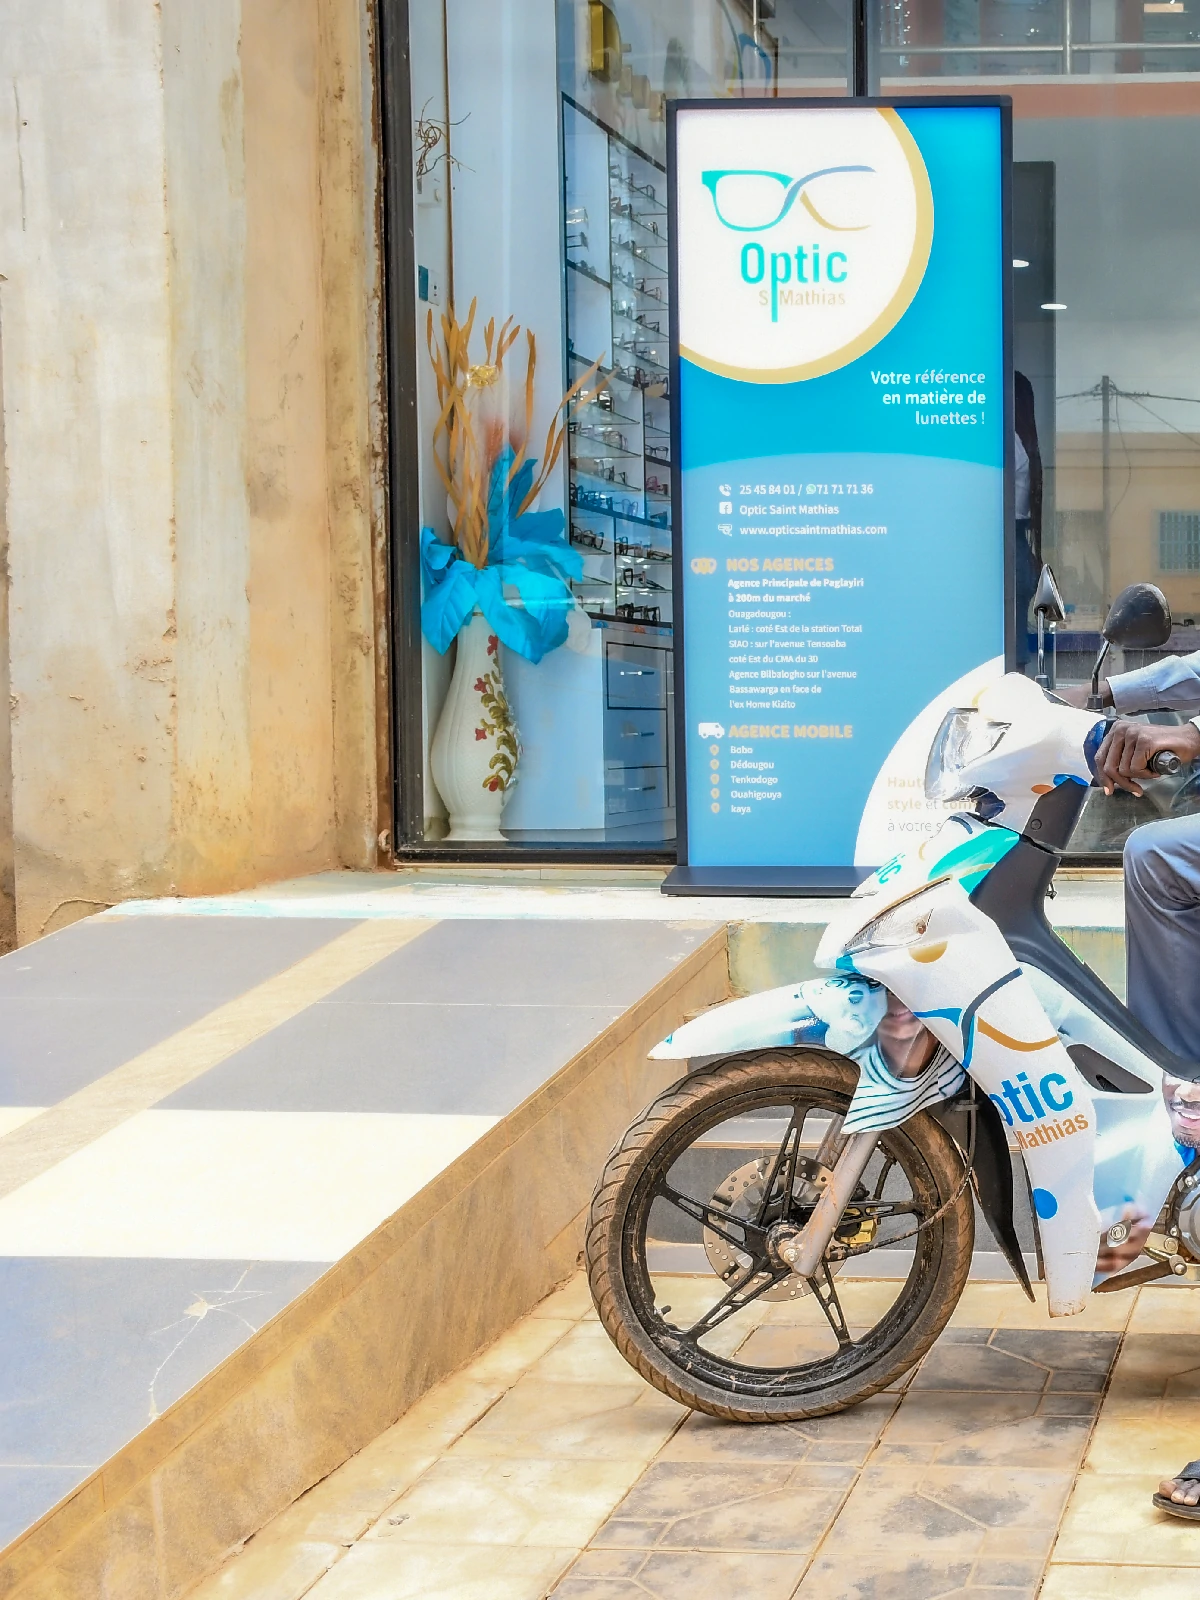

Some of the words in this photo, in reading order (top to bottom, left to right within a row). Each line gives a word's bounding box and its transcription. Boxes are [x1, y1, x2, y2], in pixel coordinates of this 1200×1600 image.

[740, 242, 848, 322] Optic
[779, 288, 845, 306] Mathias
[871, 370, 910, 384] Votre
[915, 370, 986, 384] référence
[882, 393, 900, 404] en
[906, 388, 964, 404] matière
[967, 390, 986, 404] de
[916, 411, 977, 425] lunettes
[740, 484, 751, 495] 25
[754, 484, 766, 495] 45
[769, 484, 780, 495] 84
[784, 484, 795, 495] 01
[817, 484, 828, 495] 71
[832, 484, 843, 495] 71
[847, 484, 858, 495] 71
[861, 484, 873, 495] 36
[740, 505, 767, 517] Optic
[770, 505, 796, 514] Saint
[799, 504, 839, 514] Mathias
[740, 525, 887, 536] www.opticsaintmathias.com
[726, 558, 759, 571] NOS
[762, 558, 834, 571] AGENCES
[728, 579, 760, 589] Agence
[762, 578, 808, 588] Principale
[810, 579, 821, 587] de
[824, 578, 864, 588] Paglayiri
[763, 594, 774, 602] du
[776, 592, 810, 602] marché
[728, 610, 786, 620] Ouagadougou
[729, 624, 750, 633] Larlé
[756, 624, 773, 633] coté
[775, 625, 788, 633] Est
[790, 624, 800, 633] de
[802, 624, 809, 633] la
[811, 624, 839, 633] station
[841, 624, 862, 633] Total
[770, 640, 805, 648] l'avenue
[729, 655, 747, 663] coté
[748, 655, 760, 663] Est
[763, 655, 773, 663] du
[775, 655, 794, 663] CMA
[795, 655, 806, 663] du
[729, 670, 759, 680] Agence
[822, 670, 857, 678] l'avenue
[792, 685, 809, 693] face
[729, 700, 744, 708] l'ex
[746, 700, 770, 708] Home
[772, 700, 796, 708] Kizito
[729, 725, 790, 738] AGENCE
[794, 725, 852, 738] MOBILE
[731, 746, 753, 754] Bobo
[731, 760, 774, 770] Dédougou
[731, 776, 778, 785] Tenkodogo
[888, 778, 924, 787] Haut
[731, 790, 782, 800] Ouahigouya
[731, 805, 751, 814] kaya
[888, 798, 922, 812] style
[926, 799, 937, 809] et
[898, 821, 931, 832] votre
